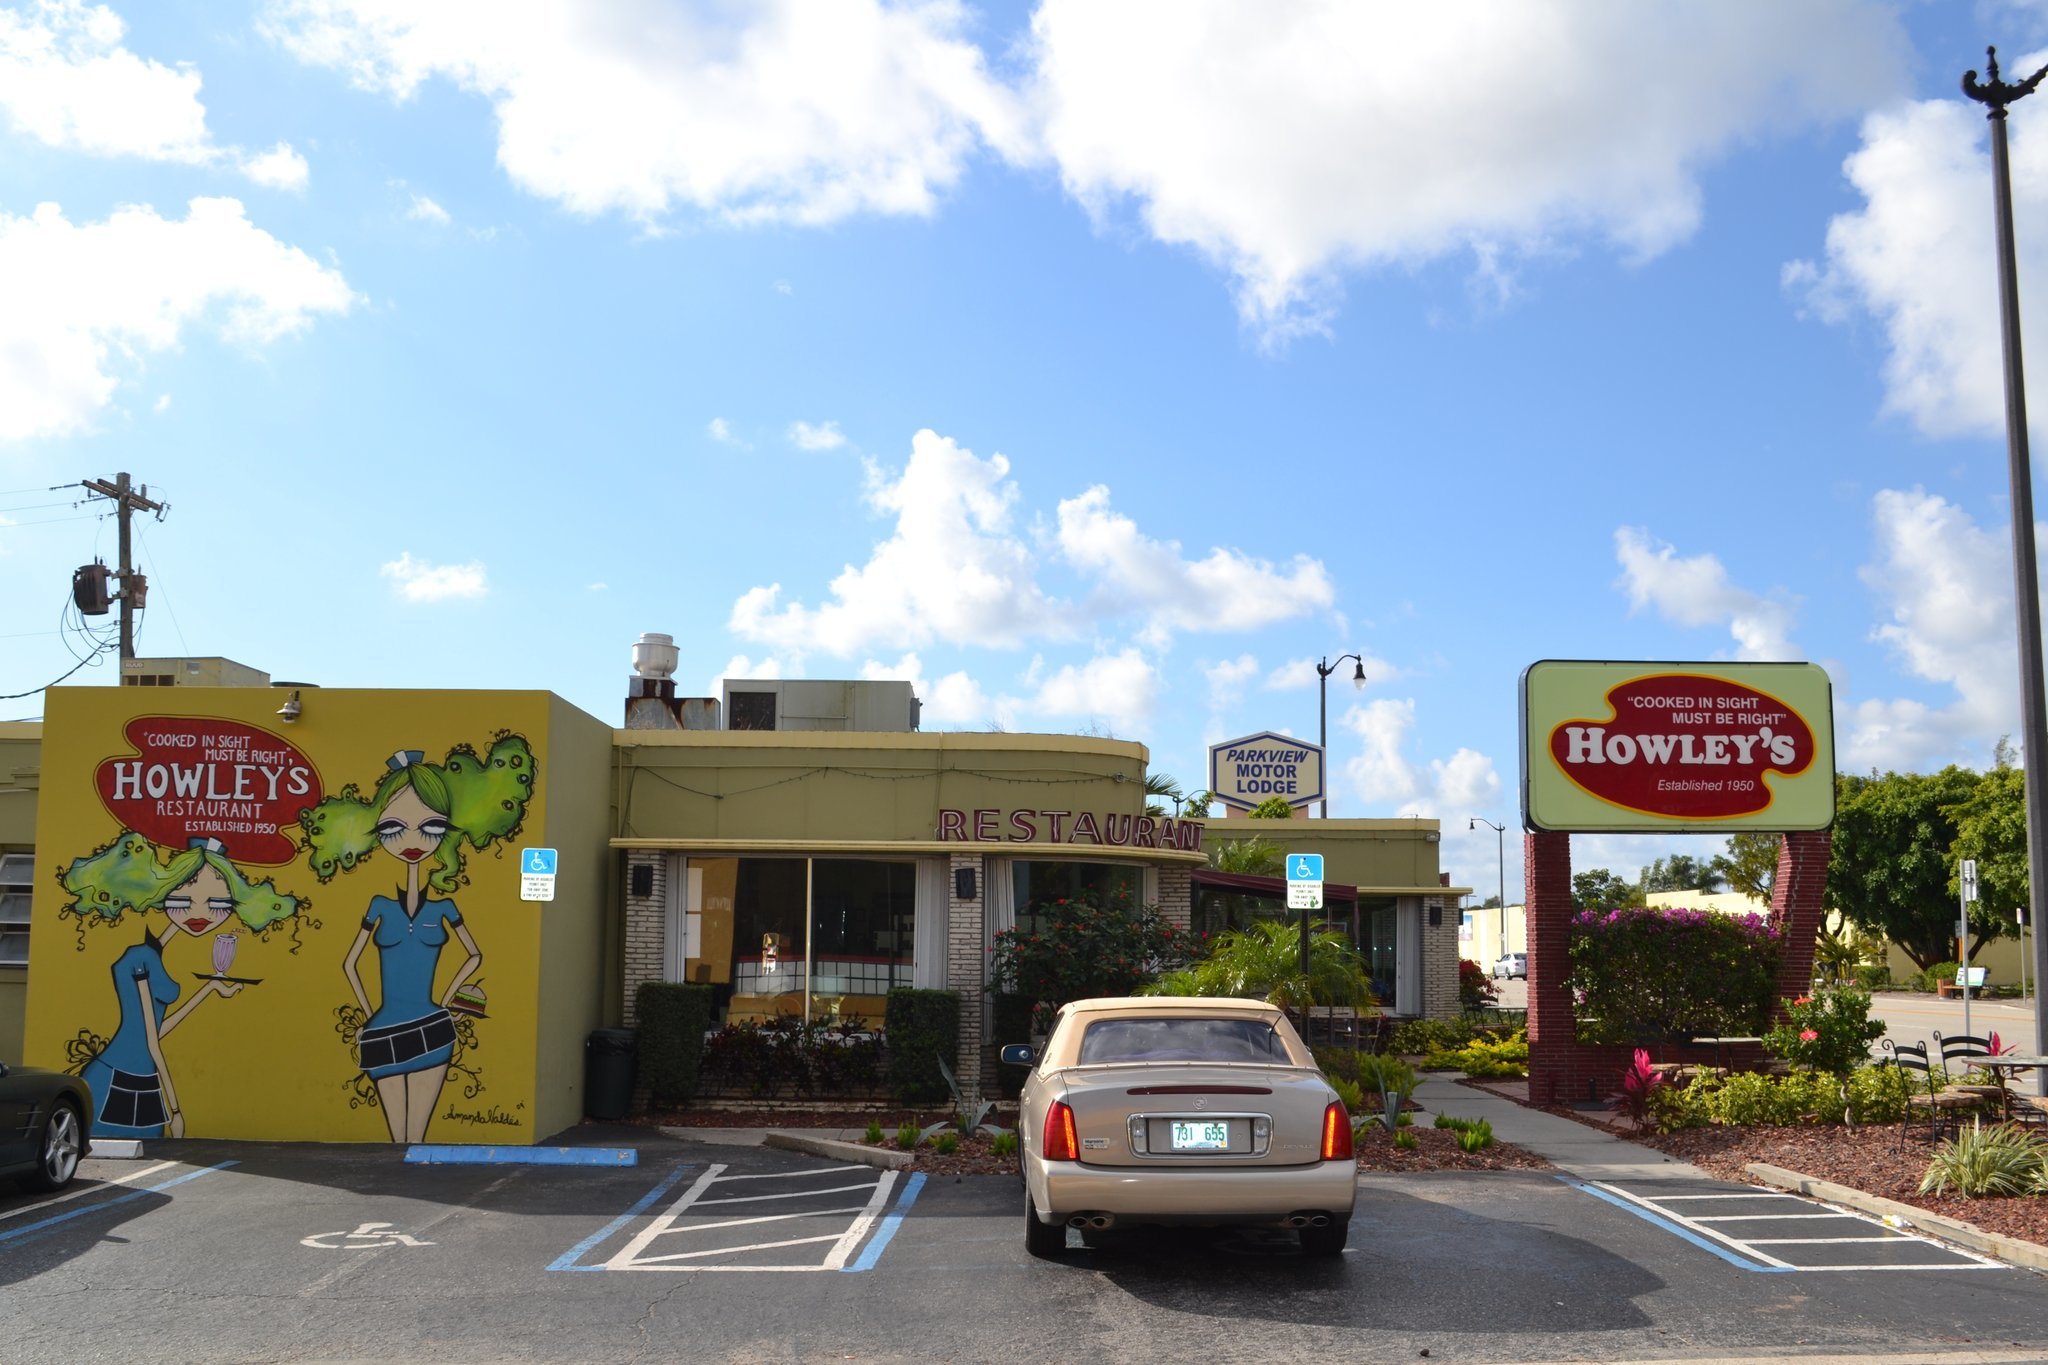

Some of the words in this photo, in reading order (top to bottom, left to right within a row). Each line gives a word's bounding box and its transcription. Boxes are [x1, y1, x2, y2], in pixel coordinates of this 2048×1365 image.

[1699, 697, 1713, 708] IN
[1716, 697, 1759, 709] SIGHT
[1672, 713, 1711, 724] MUST
[1715, 713, 1734, 724] BE
[202, 735, 215, 747] IN
[218, 735, 250, 749] SIGHT
[205, 749, 235, 762] MUST
[236, 750, 248, 762] BE
[1226, 749, 1309, 763] PARKVIEW
[1236, 764, 1297, 778] MOTOR
[1237, 780, 1297, 794] LODGE
[1657, 779, 1723, 791] Established
[1726, 780, 1754, 791] 1950
[157, 801, 263, 819] RESTAURANT
[185, 821, 252, 833] ESTABLISHED
[254, 823, 276, 834] 1950
[939, 809, 1206, 852] RESTAURANT
[1175, 1126, 1193, 1141] 731
[1204, 1126, 1225, 1141] 655
